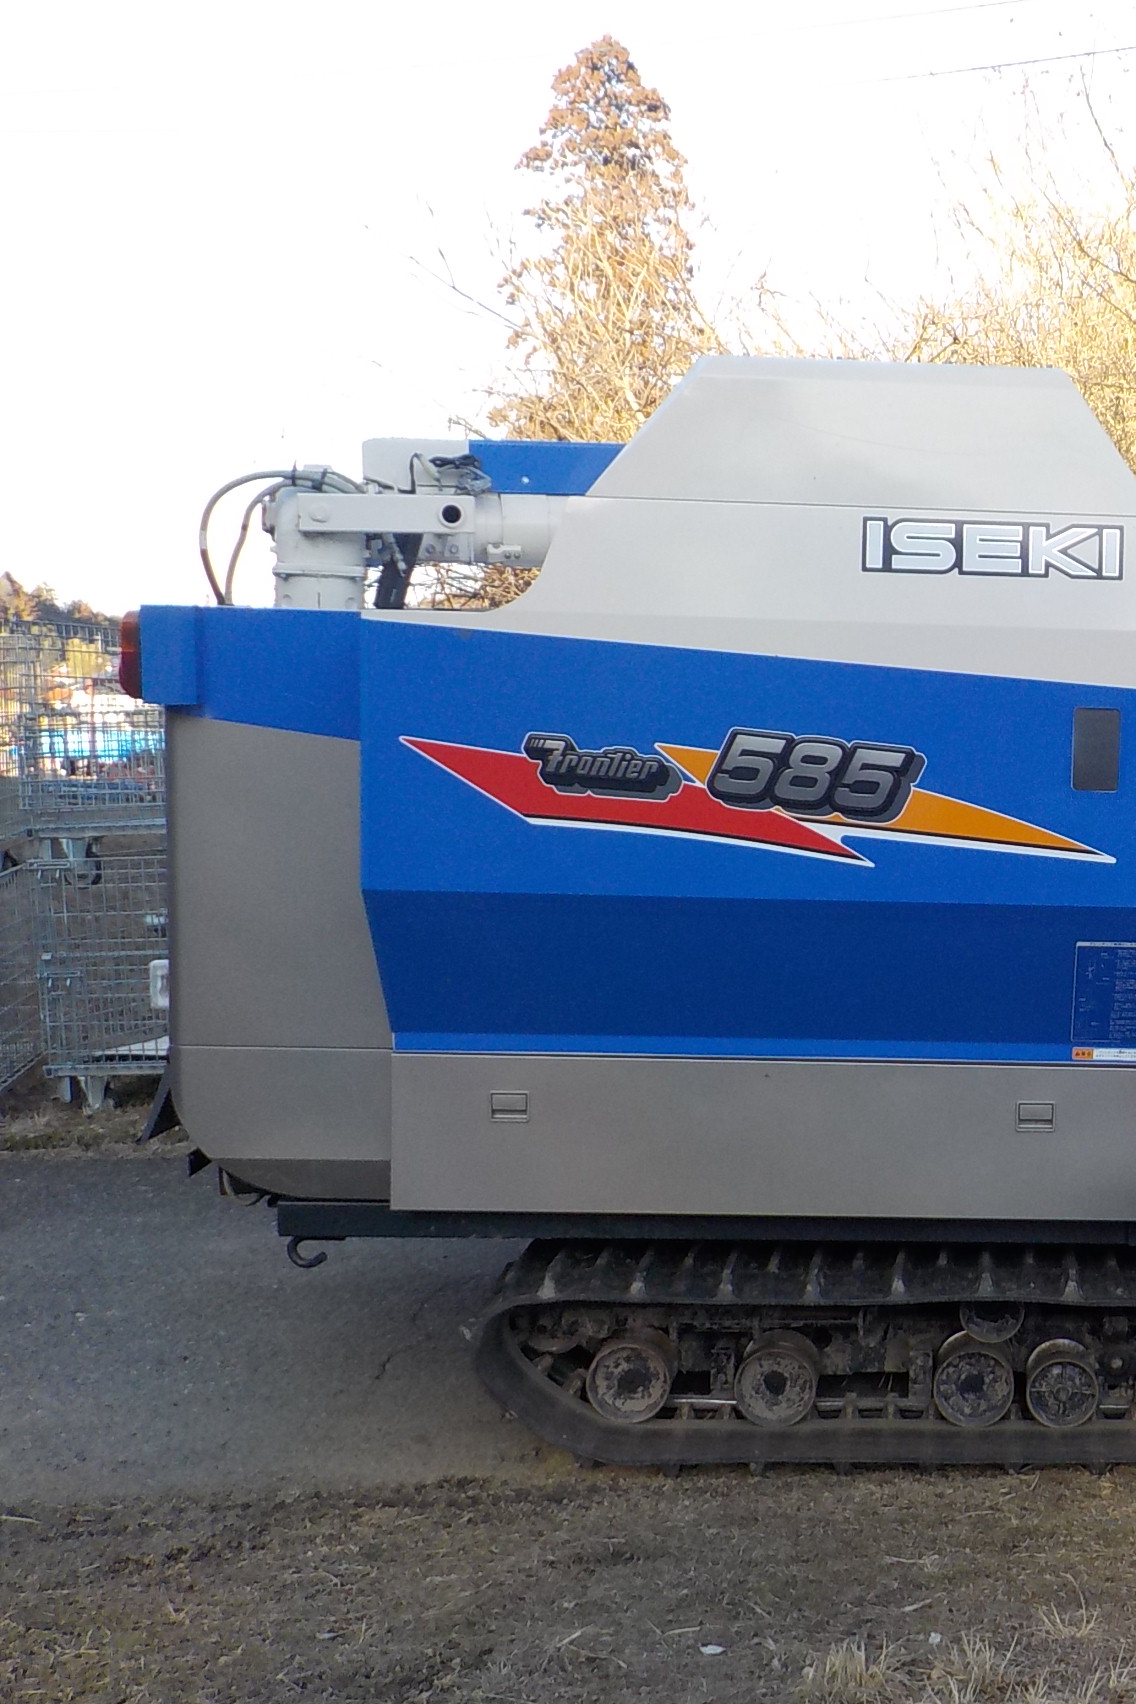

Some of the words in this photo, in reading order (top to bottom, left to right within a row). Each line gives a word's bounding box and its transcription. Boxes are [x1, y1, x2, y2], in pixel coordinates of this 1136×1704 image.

[862, 516, 1125, 580] ISEKI
[529, 735, 667, 784] Frontier
[712, 732, 908, 812] 585
